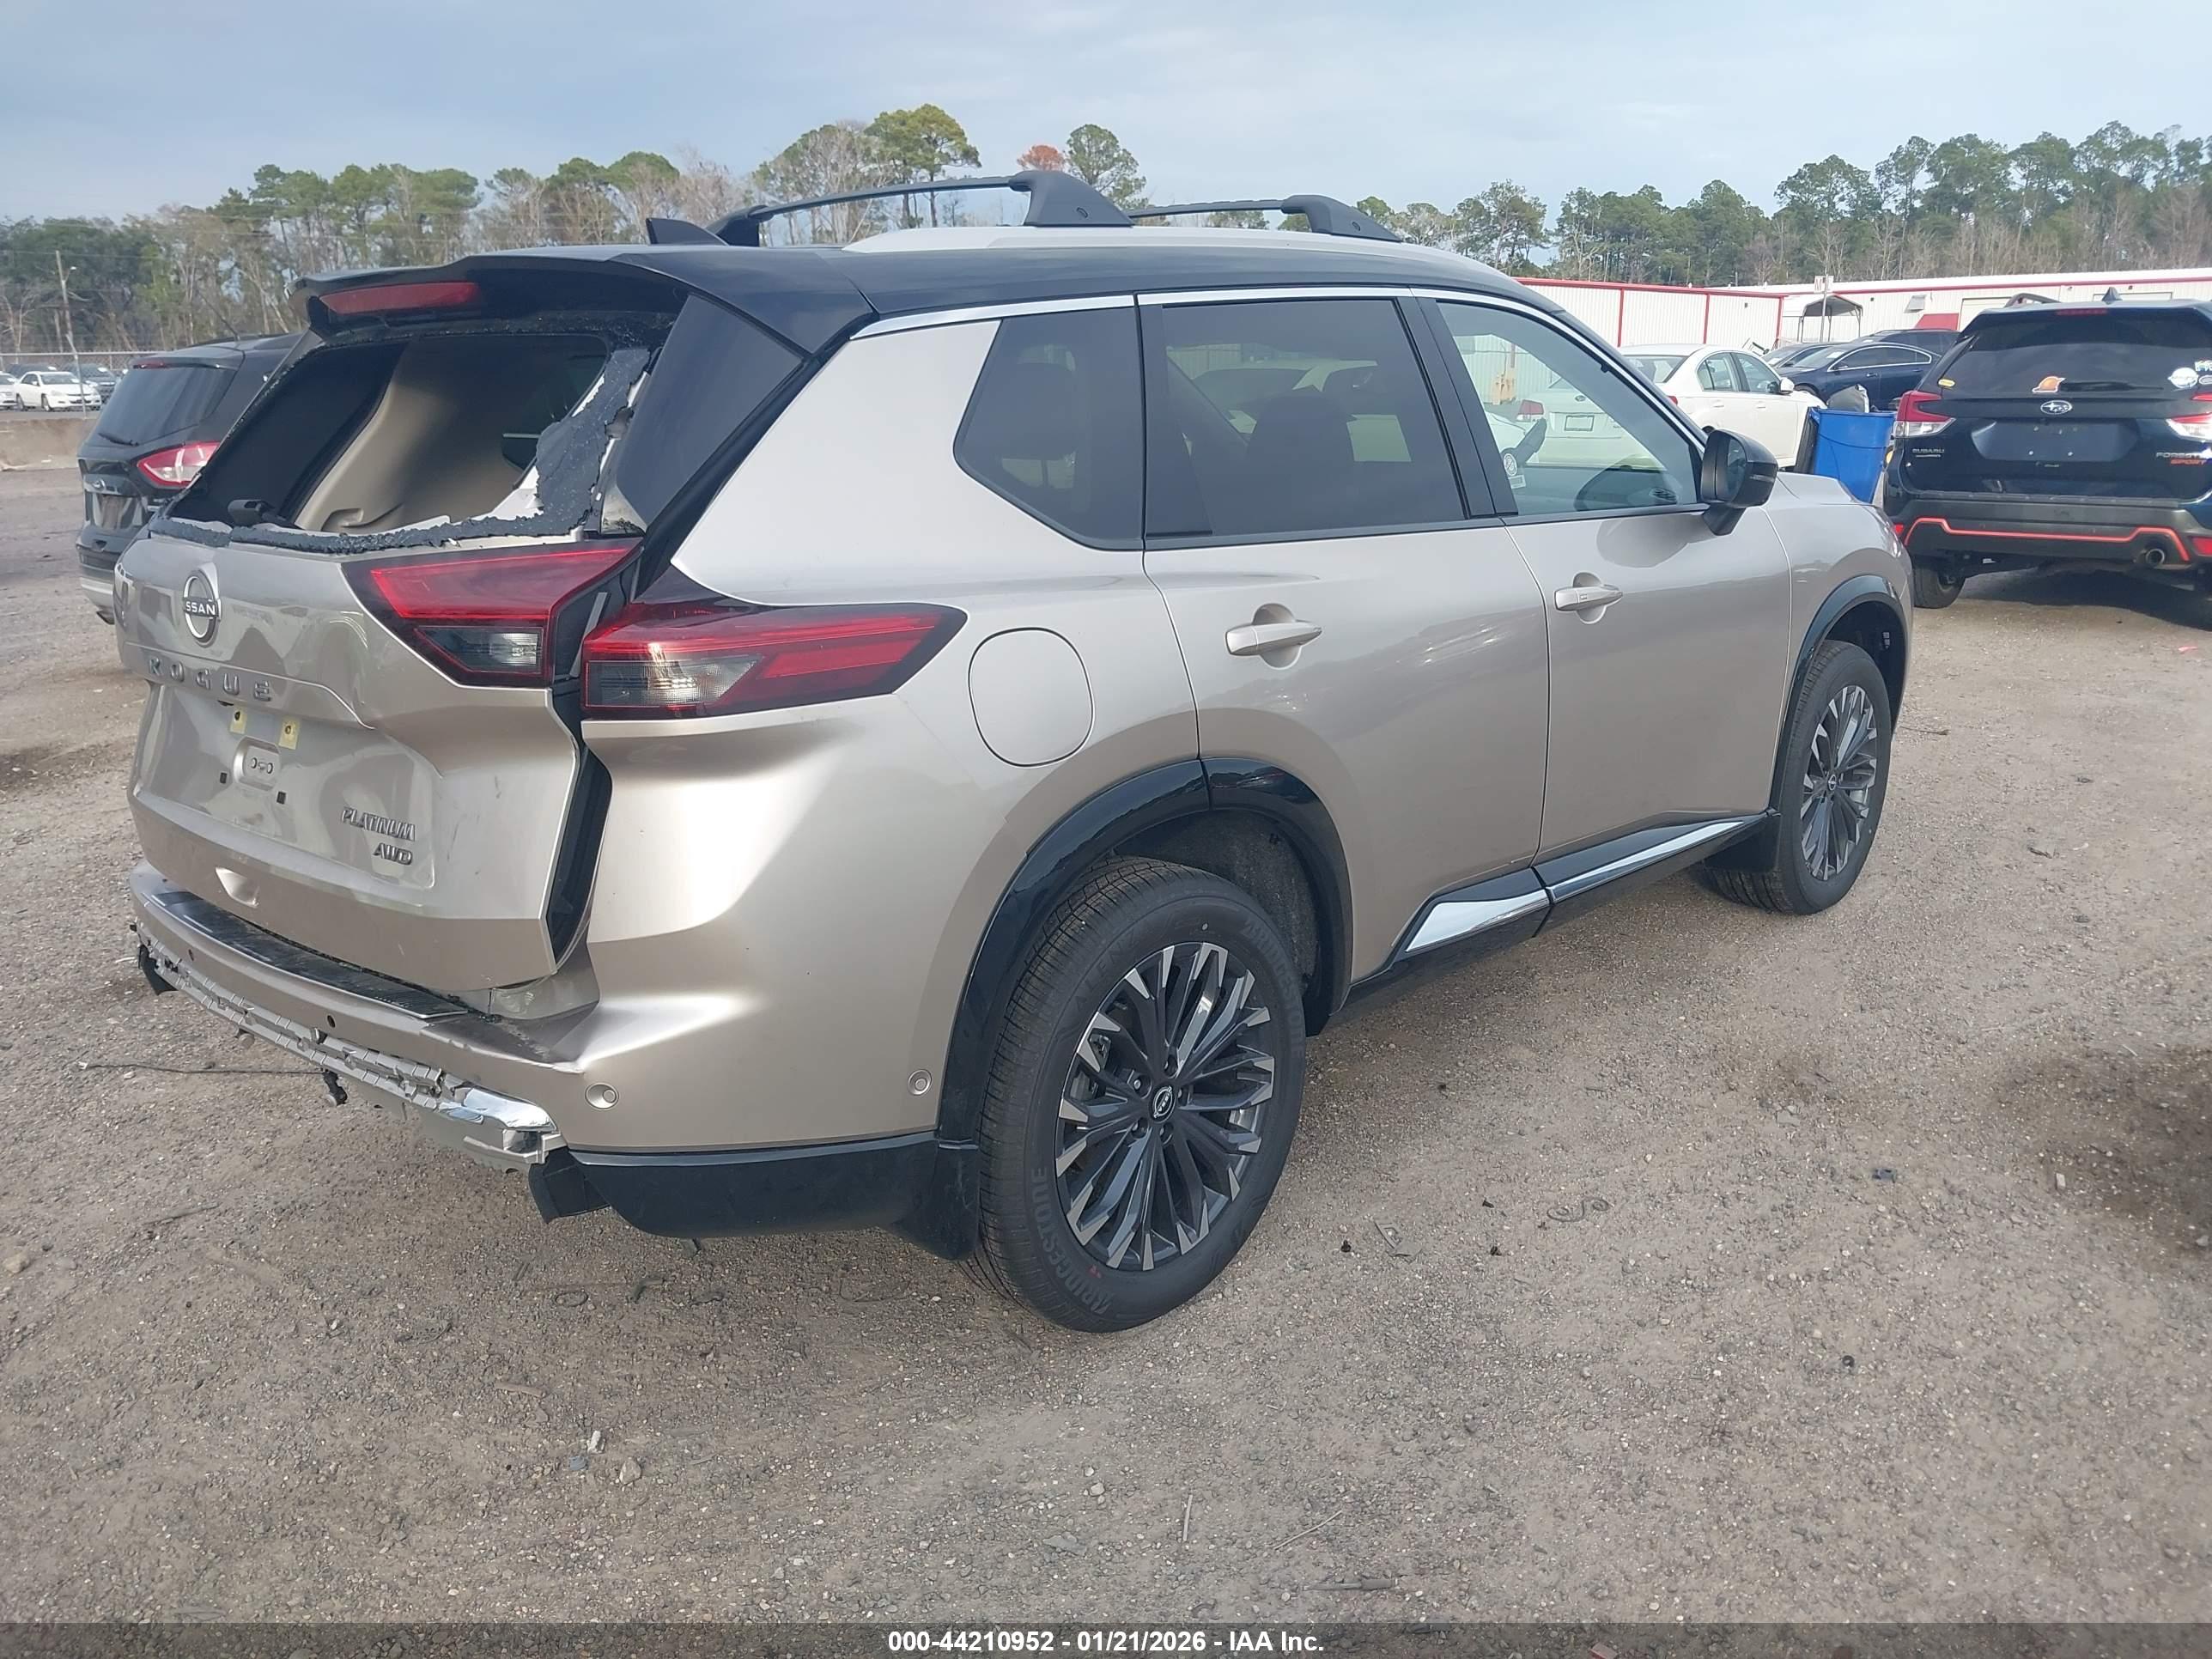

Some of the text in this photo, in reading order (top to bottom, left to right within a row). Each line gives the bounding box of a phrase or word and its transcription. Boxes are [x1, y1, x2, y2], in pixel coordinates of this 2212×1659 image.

[149, 657, 272, 702] ROGUE
[342, 807, 416, 842] PLATINUM
[373, 842, 413, 866] AWD
[1031, 1165, 1116, 1315] BRIDGESTONE
